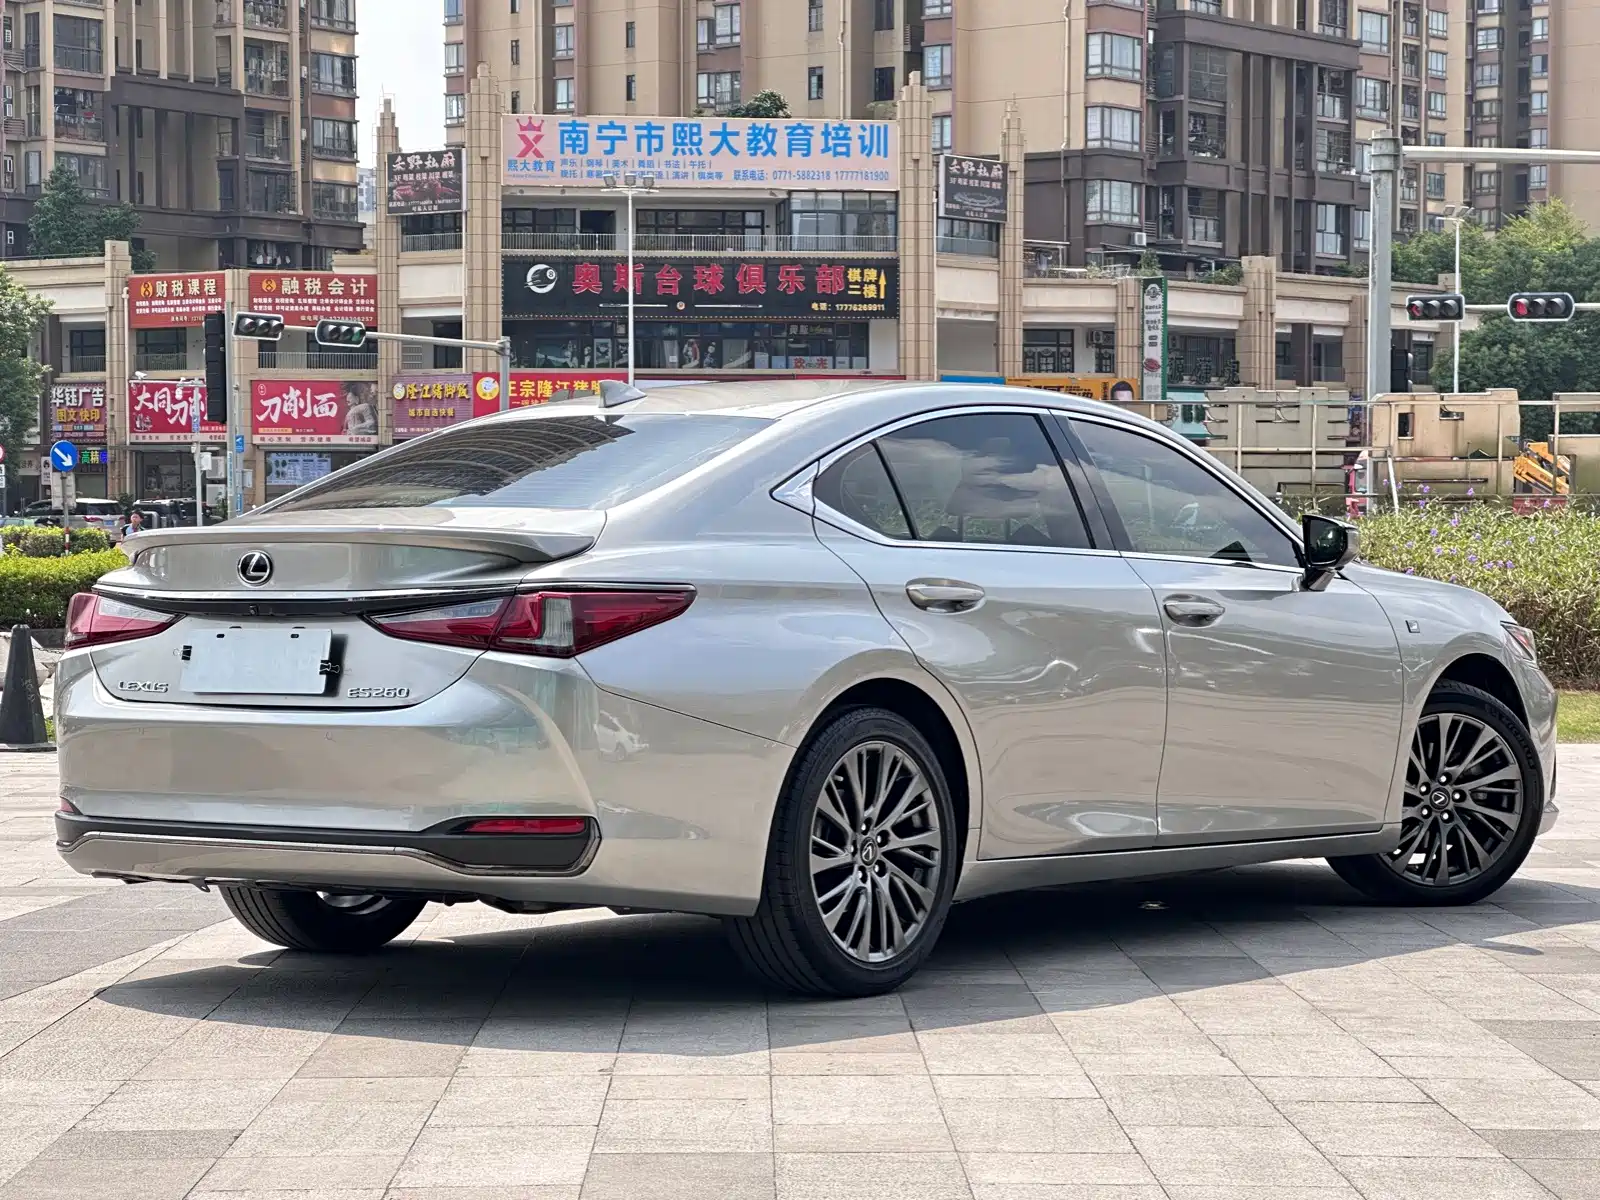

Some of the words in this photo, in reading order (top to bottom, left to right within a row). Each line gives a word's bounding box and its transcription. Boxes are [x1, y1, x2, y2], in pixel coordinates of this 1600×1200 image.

[558, 119, 888, 158] 南宁市熙大教育培训
[507, 159, 556, 173] 熙大教育
[572, 261, 846, 295] 奥斯台球俱乐部
[847, 268, 878, 283] 棋牌
[156, 278, 217, 298] 财税课程
[281, 277, 368, 296] 融税会计
[847, 284, 878, 299] 二楼
[51, 386, 104, 407] 华钰广告
[406, 383, 471, 400] 隆江猪脚饭
[256, 385, 338, 424] 刀削面
[56, 408, 77, 422] 图文
[79, 408, 100, 422] 快印
[118, 680, 169, 694] LEXUS
[347, 687, 410, 699] ES260
